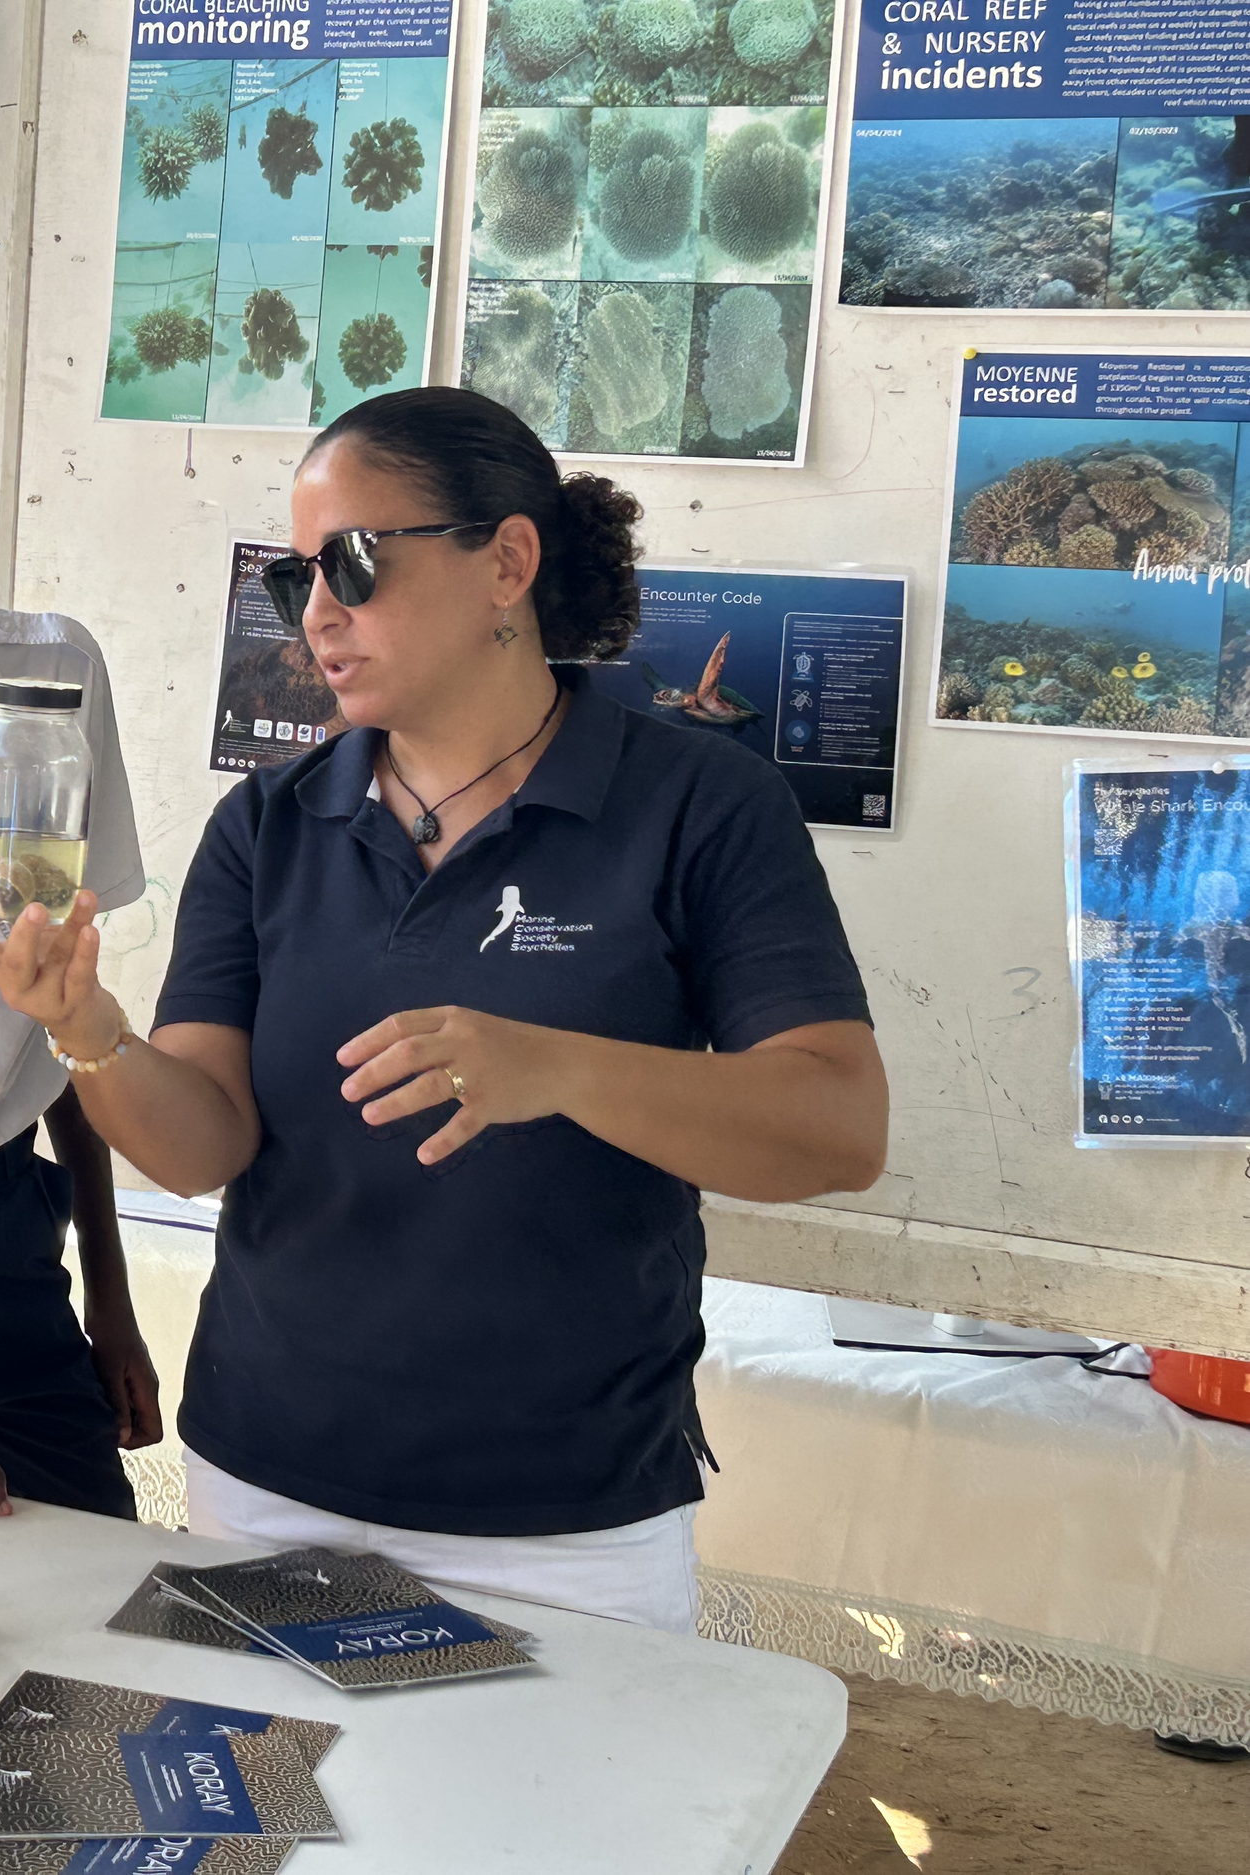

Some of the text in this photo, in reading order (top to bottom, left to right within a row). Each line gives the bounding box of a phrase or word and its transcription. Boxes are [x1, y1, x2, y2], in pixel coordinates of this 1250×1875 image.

[139, 0, 310, 14] CORAL BLEACHING
[884, 0, 1048, 23] CORAL REEF
[138, 13, 310, 50] monitoring
[882, 30, 1046, 55] & NURSERY
[881, 58, 1044, 90] incidents
[976, 366, 1078, 383] MOYENNE
[974, 384, 1077, 404] restored
[240, 548, 255, 557] The
[1133, 548, 1198, 585] Annou
[640, 586, 762, 605] Encounter Code
[1095, 800, 1145, 814] Whale
[1151, 799, 1198, 812] Shark
[515, 914, 556, 923] Marine
[514, 924, 593, 933] Conservation
[510, 943, 575, 952] Seychelles
[513, 934, 559, 943] Society
[334, 1626, 454, 1654] KORAY
[184, 1752, 235, 1816] KORAY
